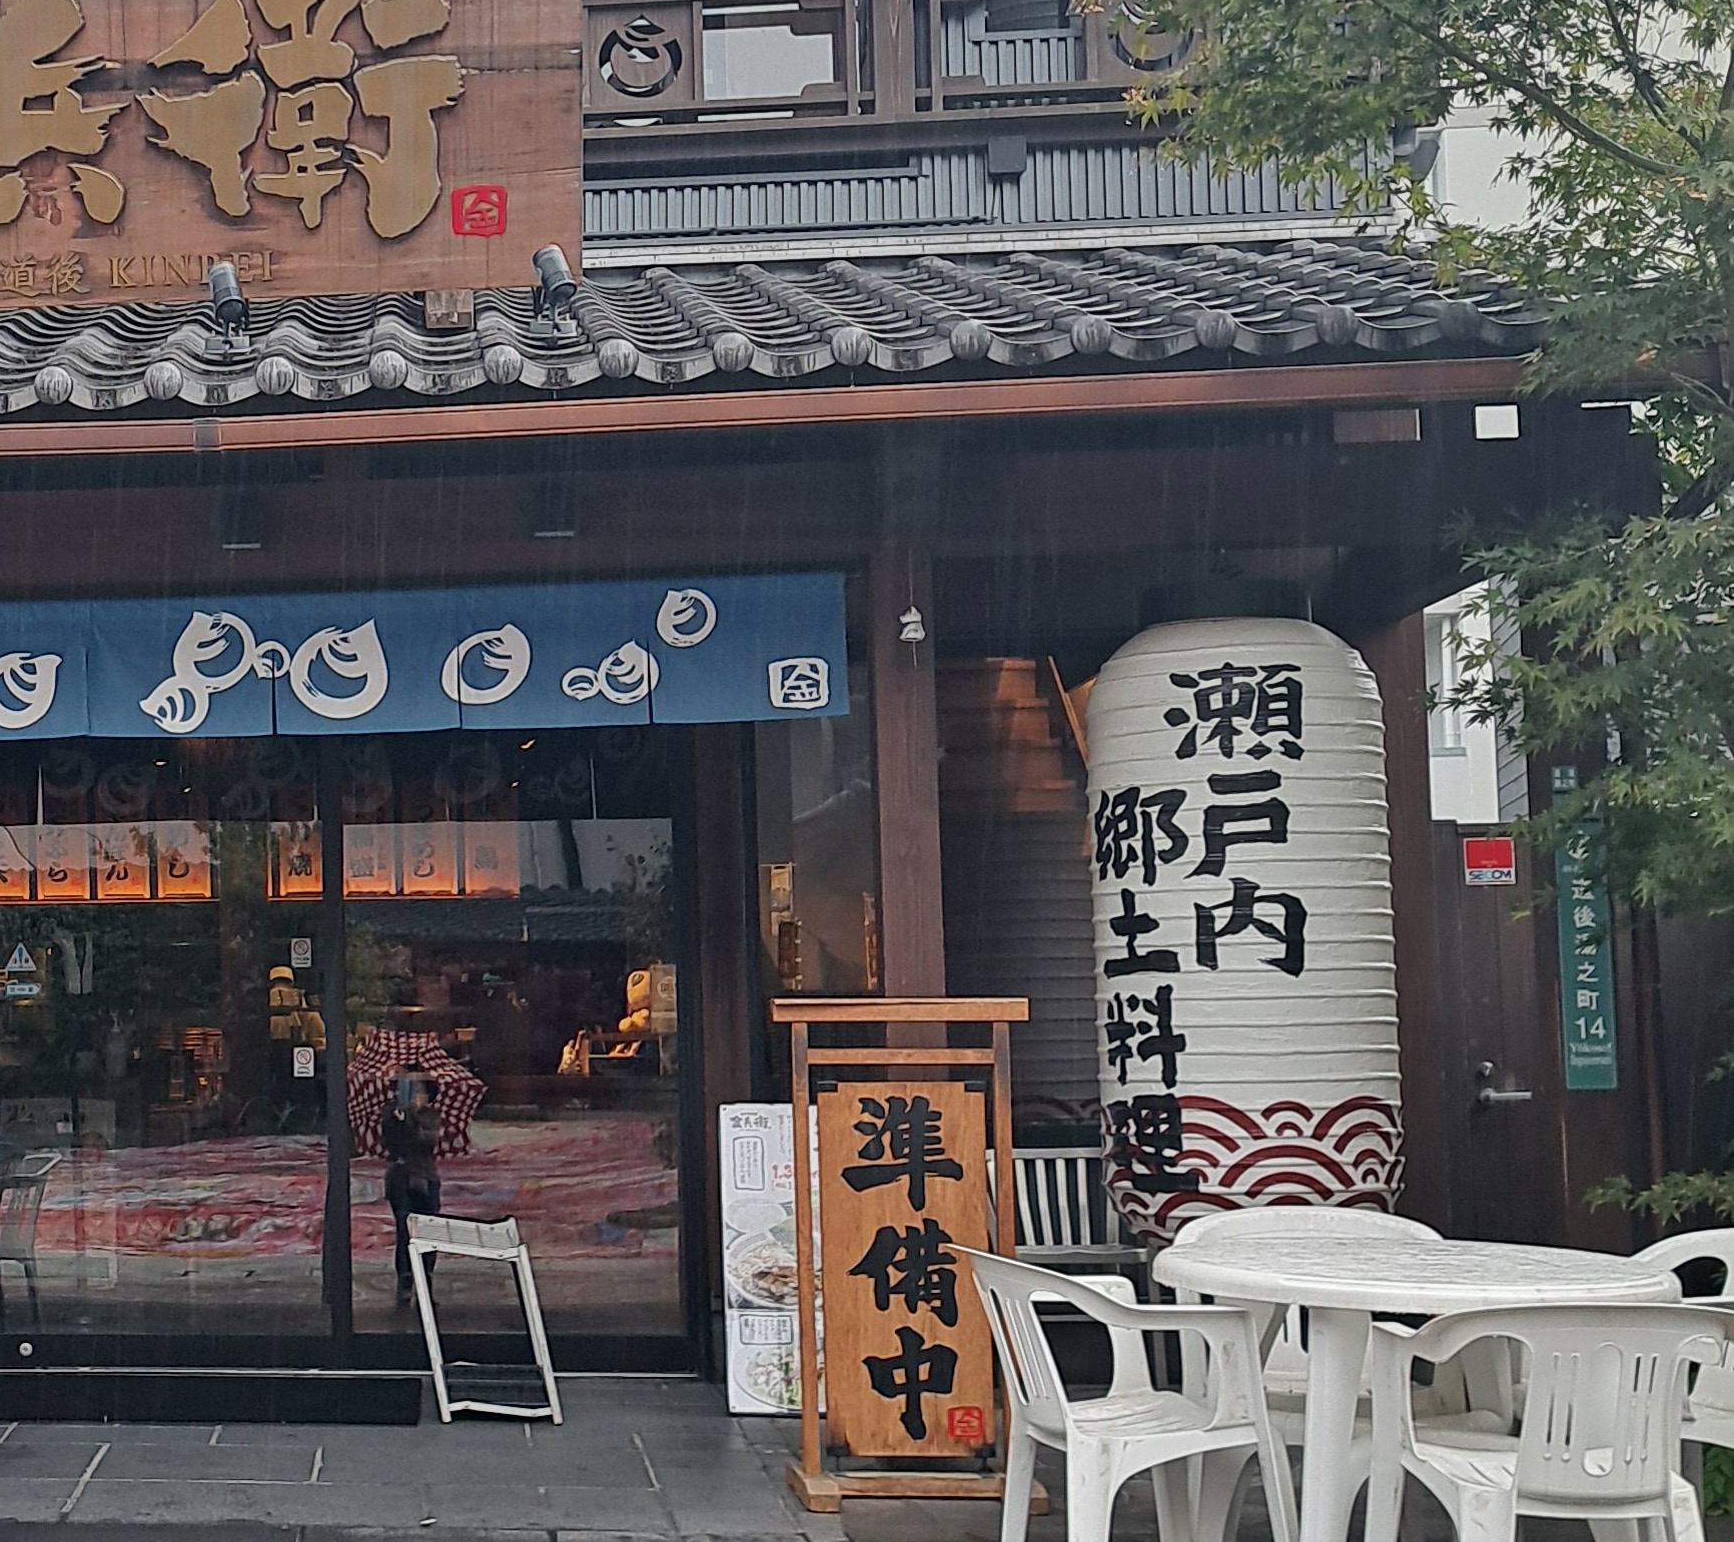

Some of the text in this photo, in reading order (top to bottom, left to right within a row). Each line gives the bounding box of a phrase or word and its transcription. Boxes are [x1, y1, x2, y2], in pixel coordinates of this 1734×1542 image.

[1163, 661, 1308, 978] 瀬戸内
[1468, 869, 1512, 880] SECOM
[1094, 786, 1200, 1194] 郷土料理
[1574, 1016, 1607, 1040] 14
[841, 1095, 964, 1441] 準備中
